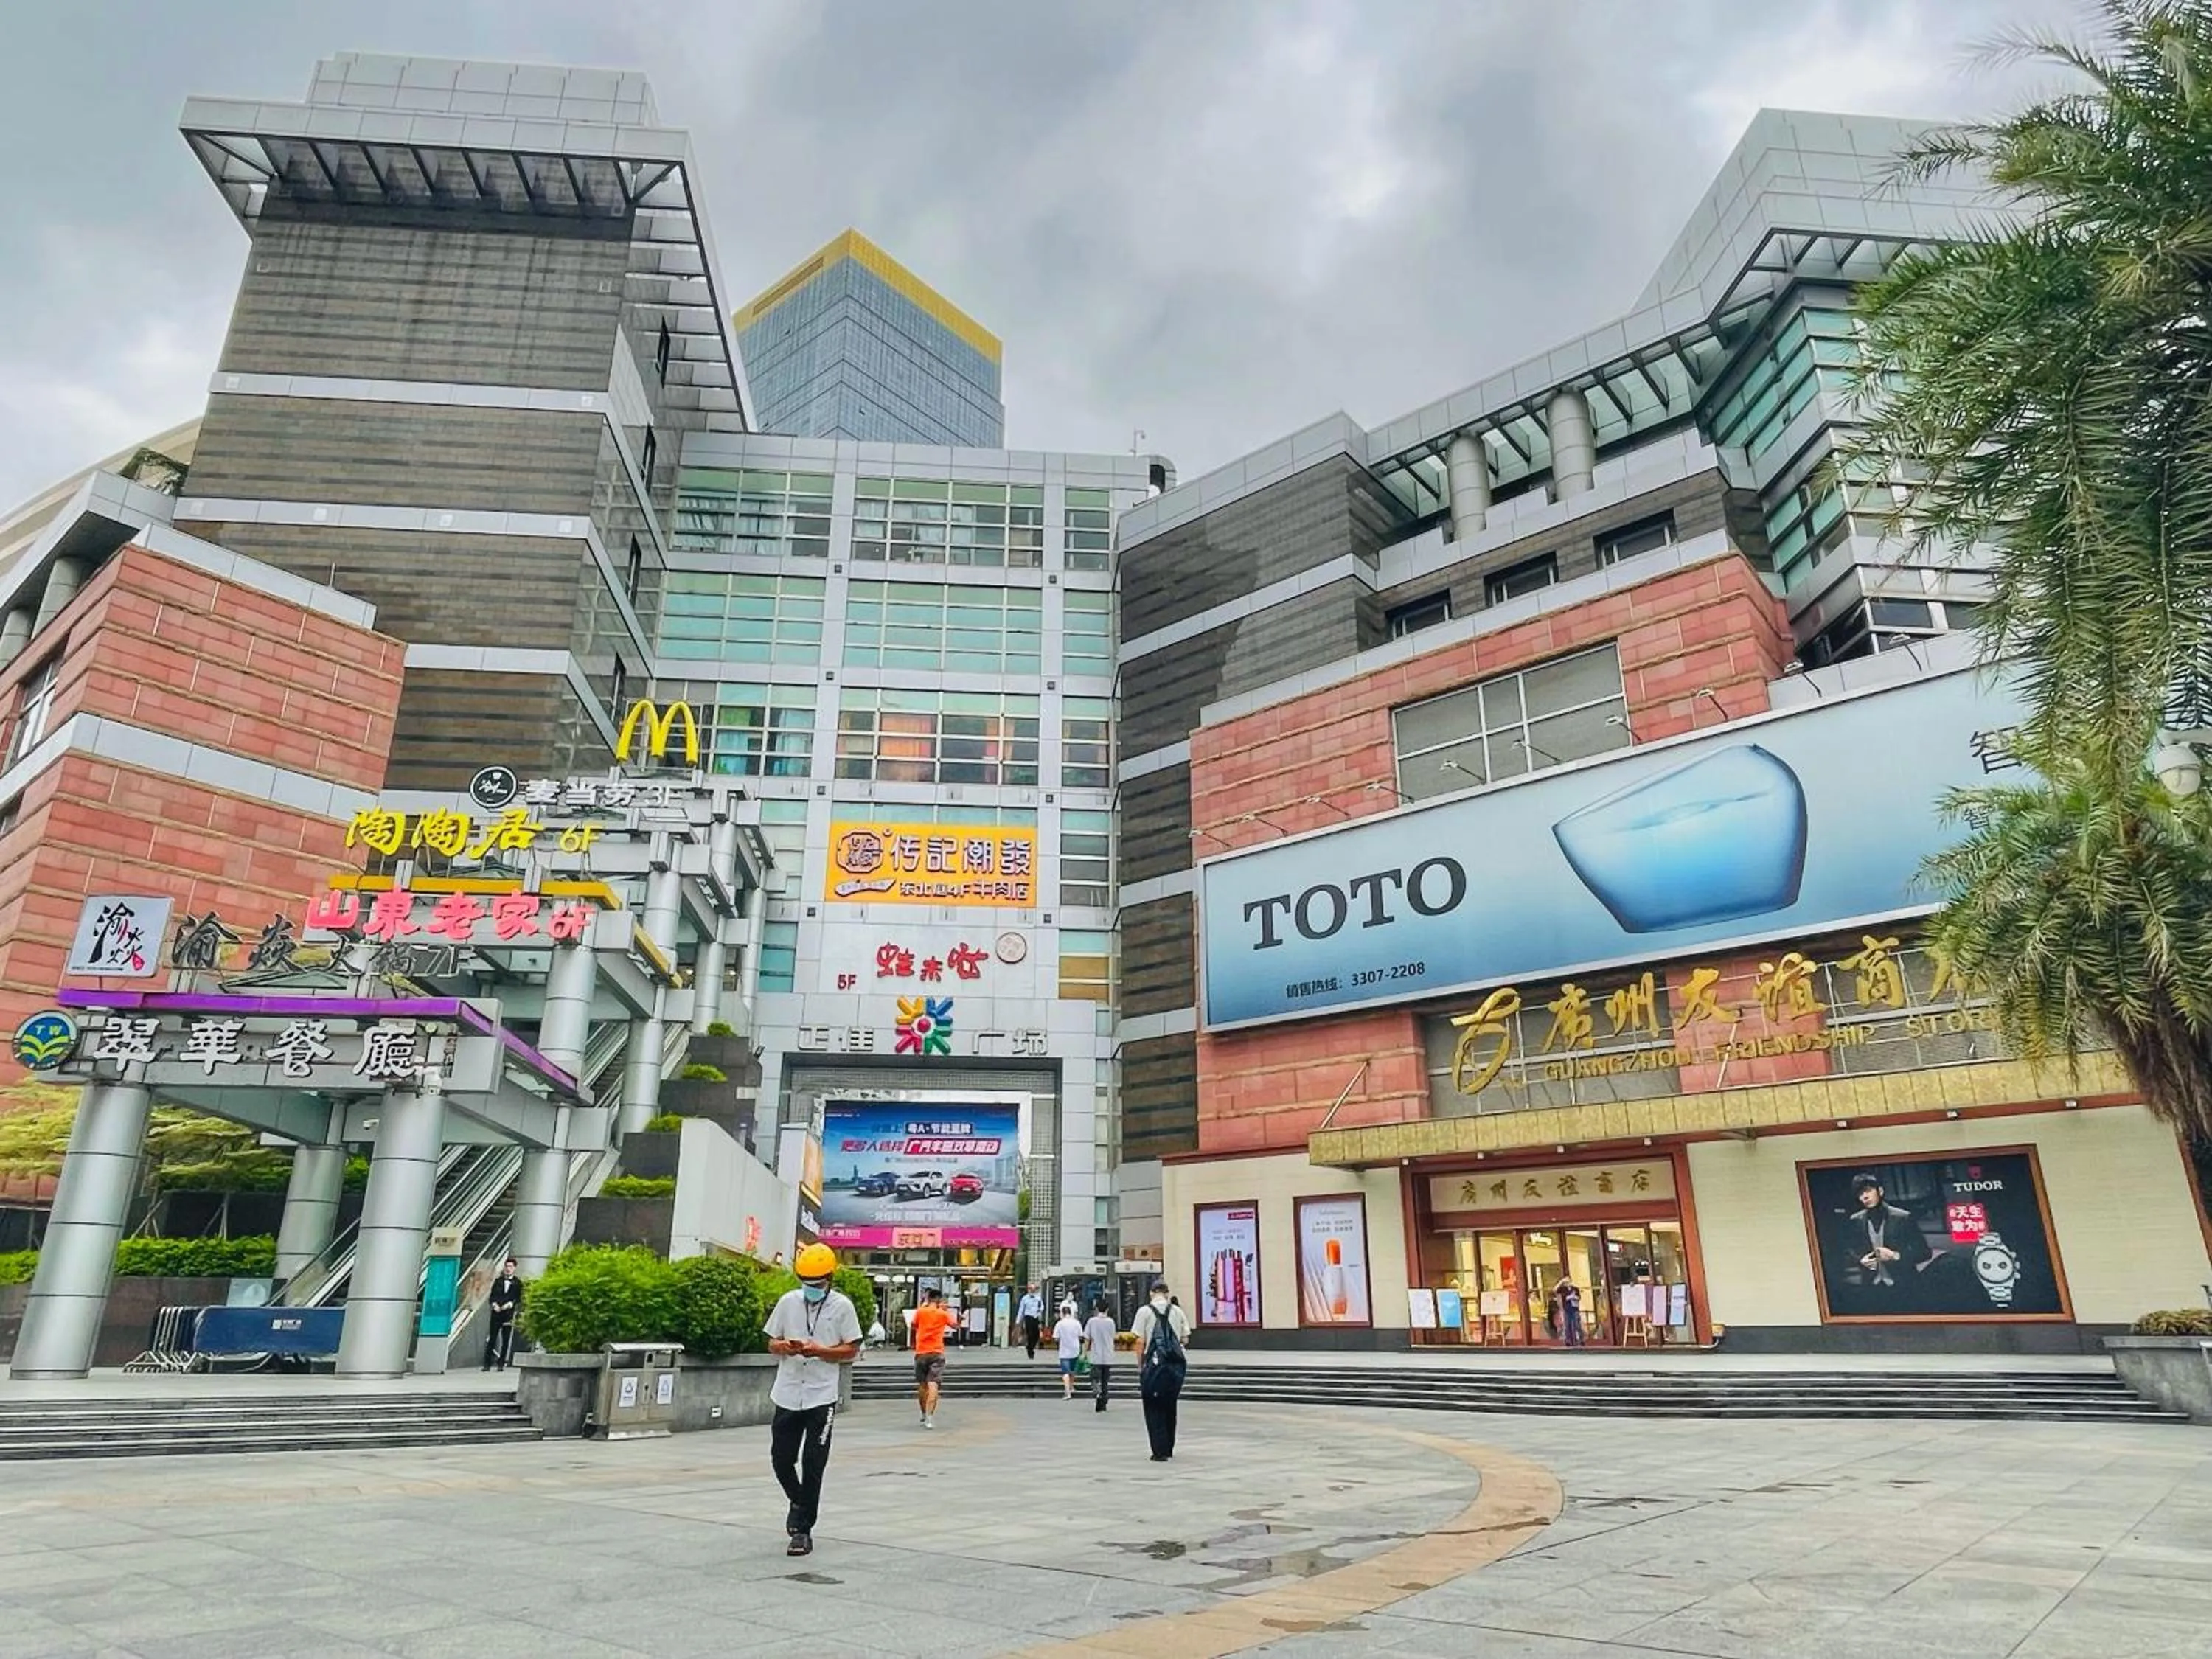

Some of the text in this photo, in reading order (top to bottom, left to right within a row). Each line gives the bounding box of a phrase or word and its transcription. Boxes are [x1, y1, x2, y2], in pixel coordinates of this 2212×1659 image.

[525, 779, 636, 806] 麦当劳
[644, 785, 684, 807] 3F
[345, 807, 604, 860] 陶陶居 6F
[1244, 856, 1467, 950] TOTO
[549, 907, 597, 940] 6F
[837, 974, 858, 990] 5F
[1351, 961, 1425, 986] 3307-2208
[94, 1018, 417, 1077] 翠華餐廳
[797, 1026, 1049, 1056] 正佳 广场
[1545, 1046, 1692, 1081] GUANGZHOU
[1715, 1023, 1876, 1061] FRIENDSHIP
[1952, 1180, 2003, 1192] TUDOR
